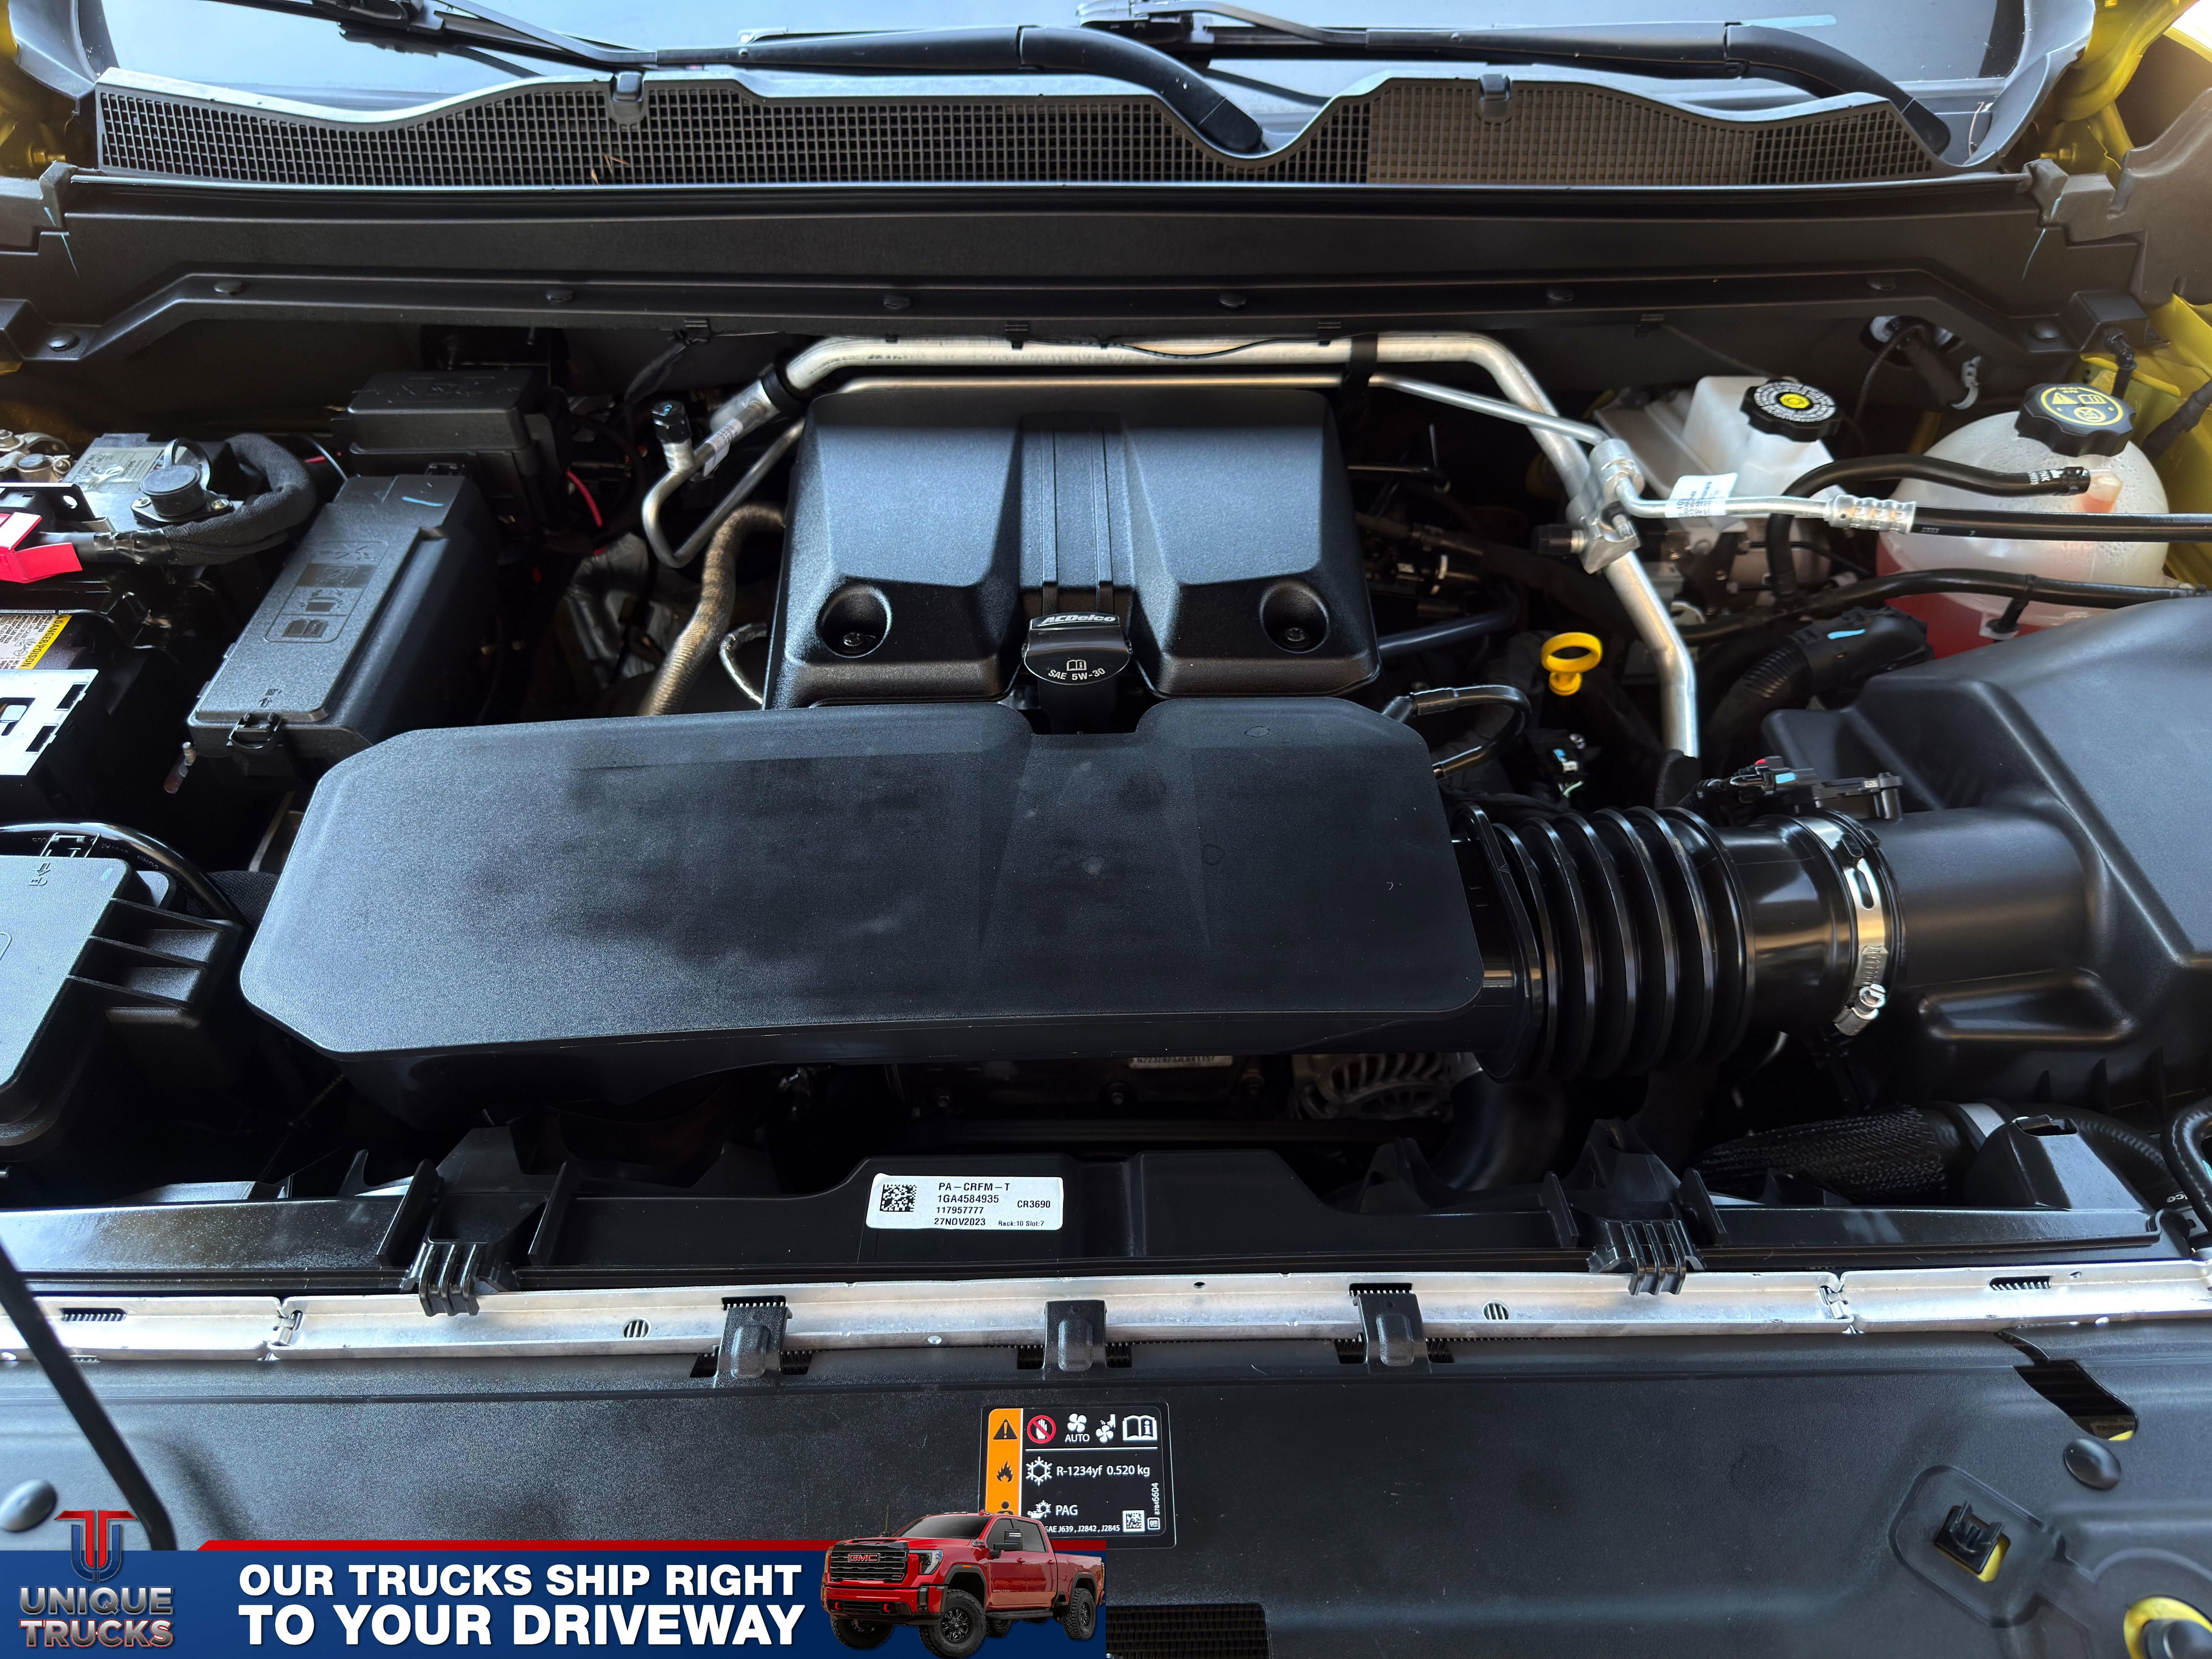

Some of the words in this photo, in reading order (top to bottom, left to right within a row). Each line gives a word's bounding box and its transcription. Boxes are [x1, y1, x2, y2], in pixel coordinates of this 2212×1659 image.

[1041, 614, 1116, 624] ACDelco
[21, 620, 64, 666] DANGER/POISON
[1048, 669, 1068, 680] SAE
[1071, 667, 1106, 681] 5W-30
[937, 1194, 999, 1204] 1GA4584935
[1017, 1200, 1051, 1209] CR3690
[936, 1206, 984, 1214] 117957777
[934, 1217, 986, 1226] 27NOV2023
[1065, 1434, 1090, 1442] AUTO
[1056, 1465, 1103, 1478] R-1234yf
[1106, 1465, 1136, 1475] 0.520
[1137, 1465, 1150, 1477] kg
[1151, 1482, 1160, 1515] 87846604
[1056, 1505, 1078, 1516] PAG
